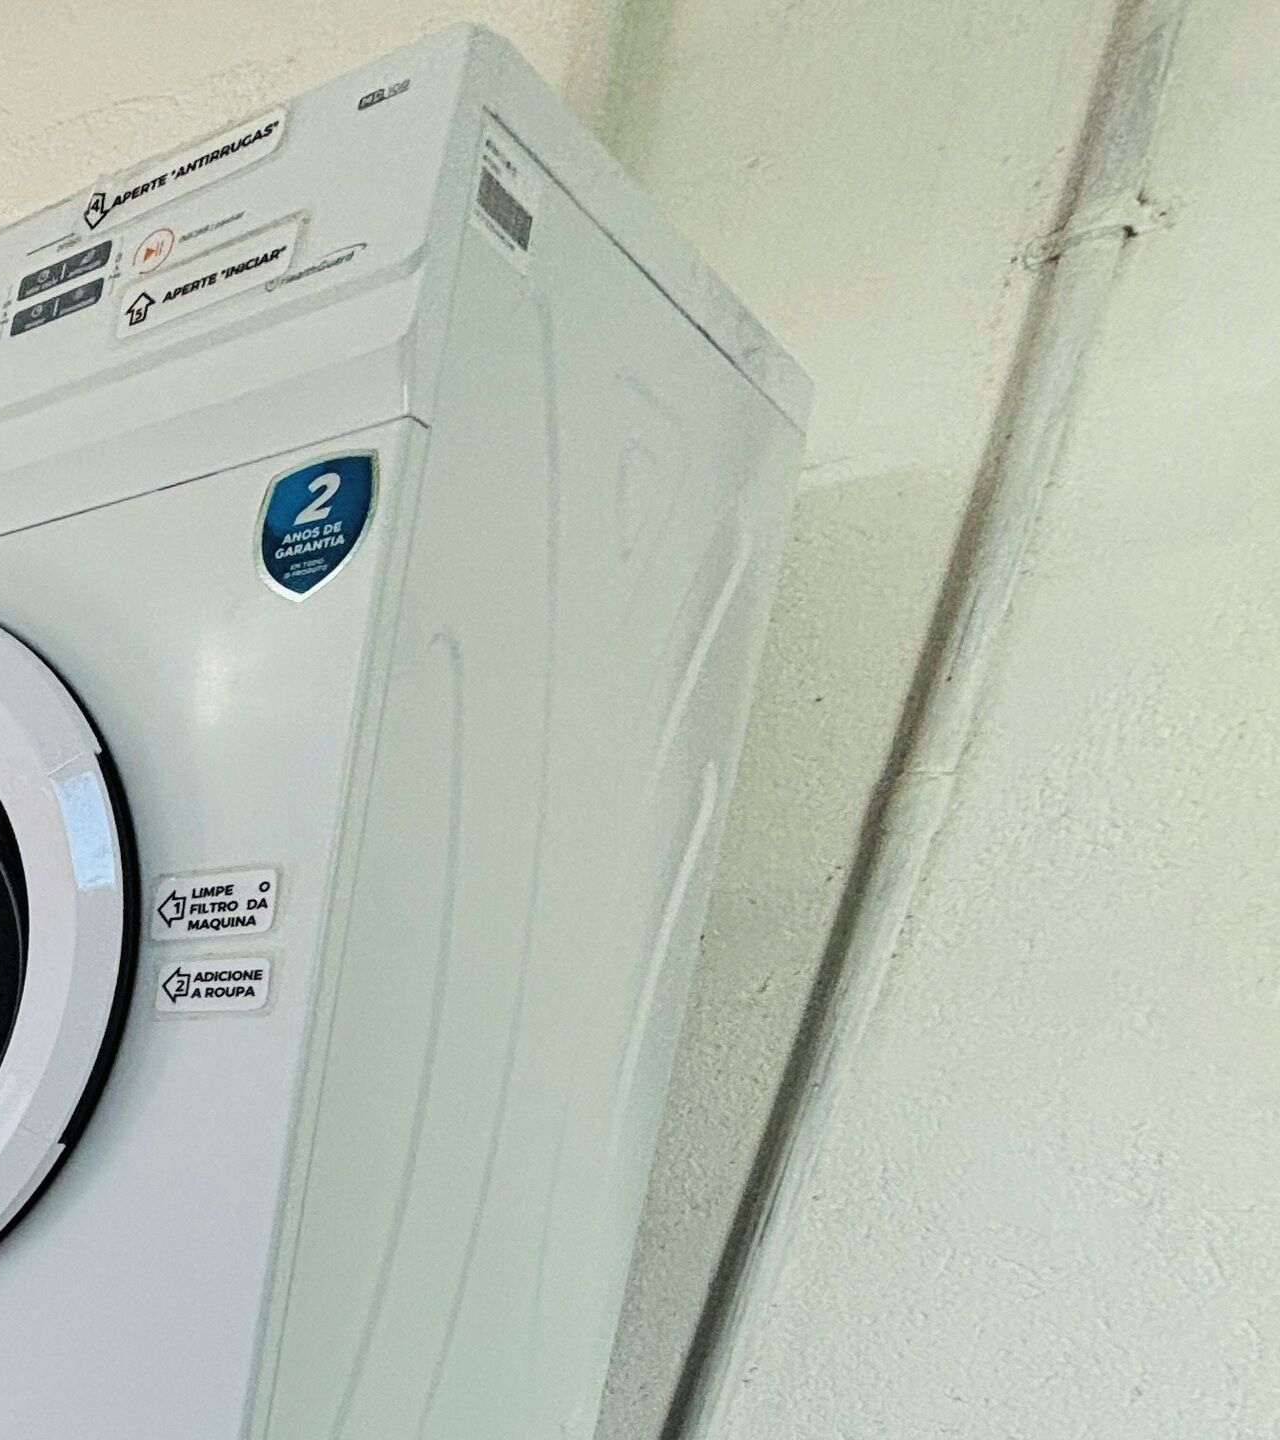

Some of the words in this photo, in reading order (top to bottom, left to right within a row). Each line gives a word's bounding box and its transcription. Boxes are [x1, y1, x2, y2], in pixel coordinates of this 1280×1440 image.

[90, 199, 100, 212] 4
[111, 174, 167, 209] APERTE
[134, 308, 143, 321] 5
[162, 272, 216, 303] APERTE
[294, 472, 341, 526] 2
[281, 526, 320, 545] ANOS
[322, 520, 343, 536] DE
[274, 534, 345, 559] GARANTIA
[173, 902, 181, 914] 1
[191, 884, 234, 899] LIMPE
[258, 881, 271, 893] O
[189, 901, 239, 915] FILTRO
[246, 898, 269, 911] DA
[187, 915, 257, 932] MAQUINA
[175, 980, 185, 993] 2
[193, 969, 263, 983] ADICIONE
[191, 988, 202, 999] A
[204, 986, 256, 999] ROUPA
